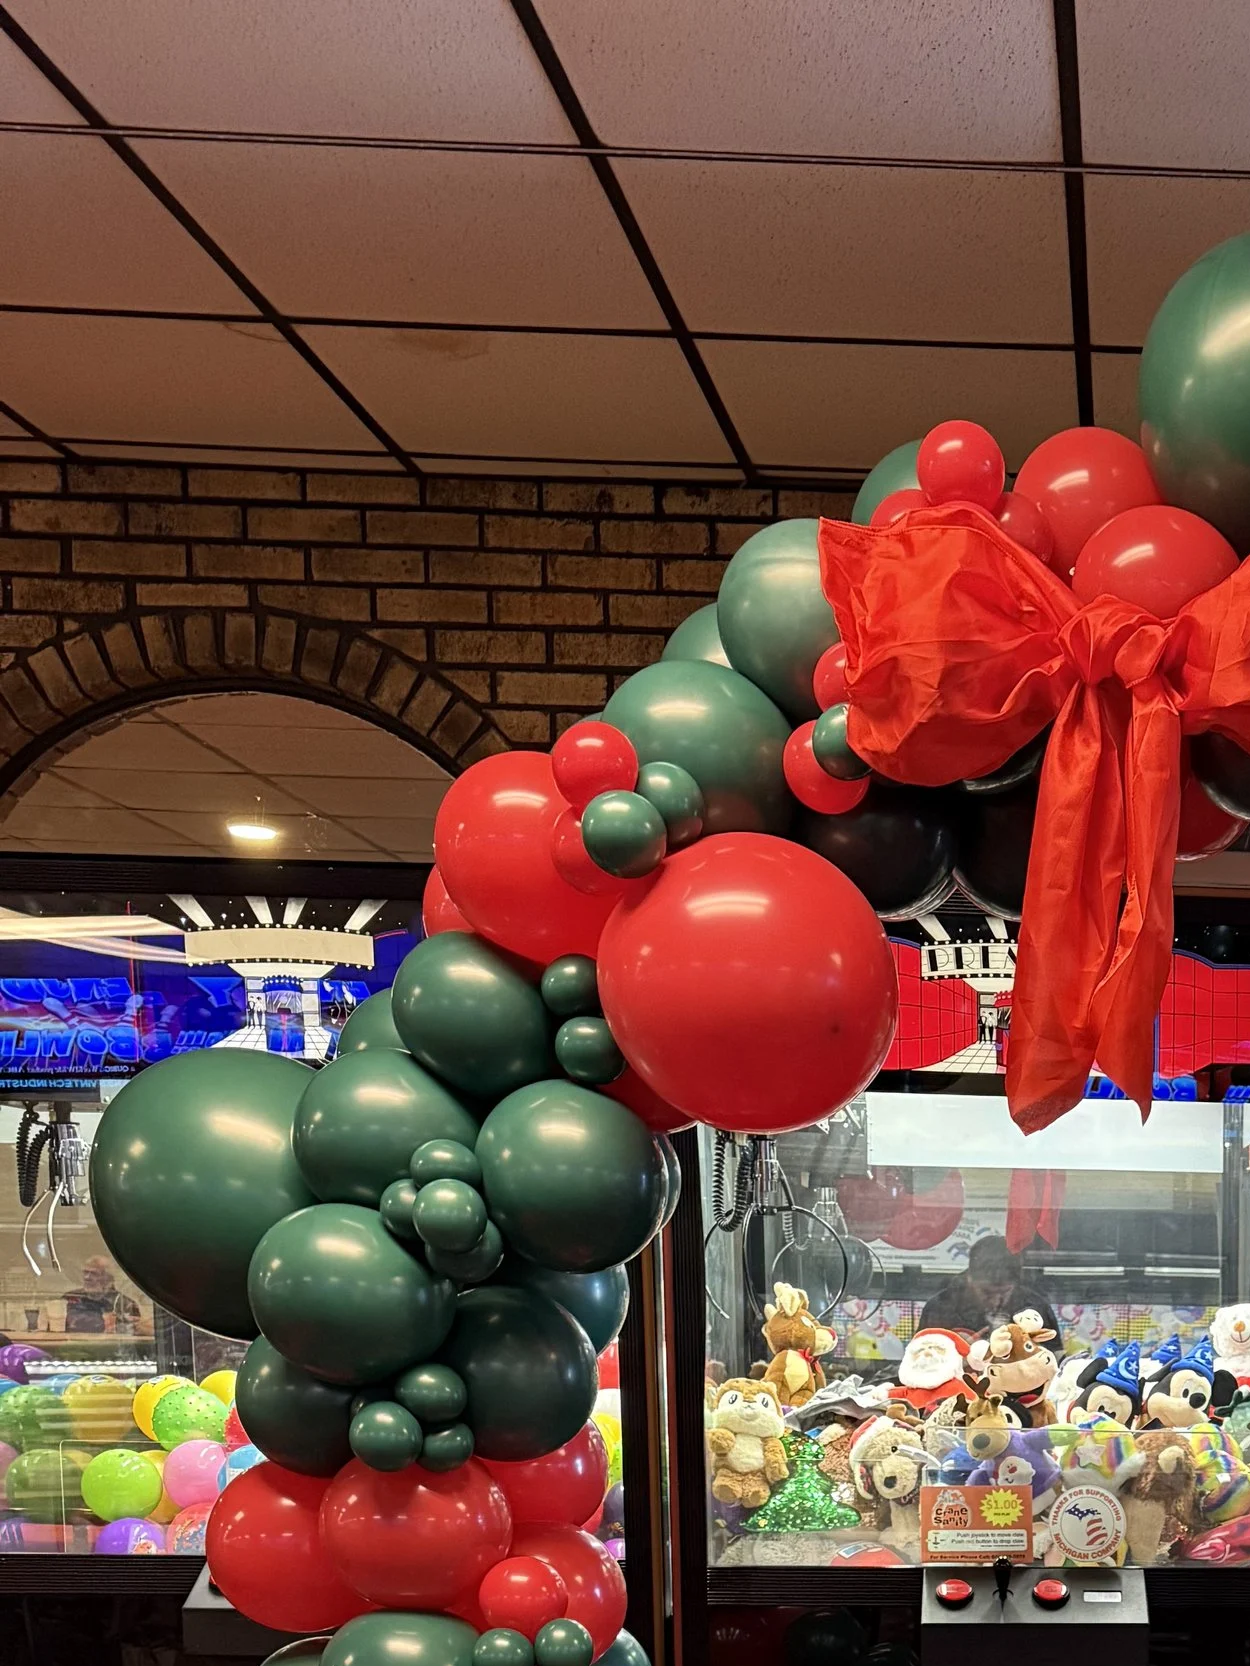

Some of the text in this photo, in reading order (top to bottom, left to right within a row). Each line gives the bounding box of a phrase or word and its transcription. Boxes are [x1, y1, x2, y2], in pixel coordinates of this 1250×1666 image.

[985, 1500, 1018, 1510] $1.00
[1052, 1489, 1121, 1525] THANKS FOR SUPPORTING
[935, 1507, 968, 1516] Crane
[934, 1517, 968, 1527] Sanity
[1053, 1529, 1121, 1559] MICHIGAN COMPANY
